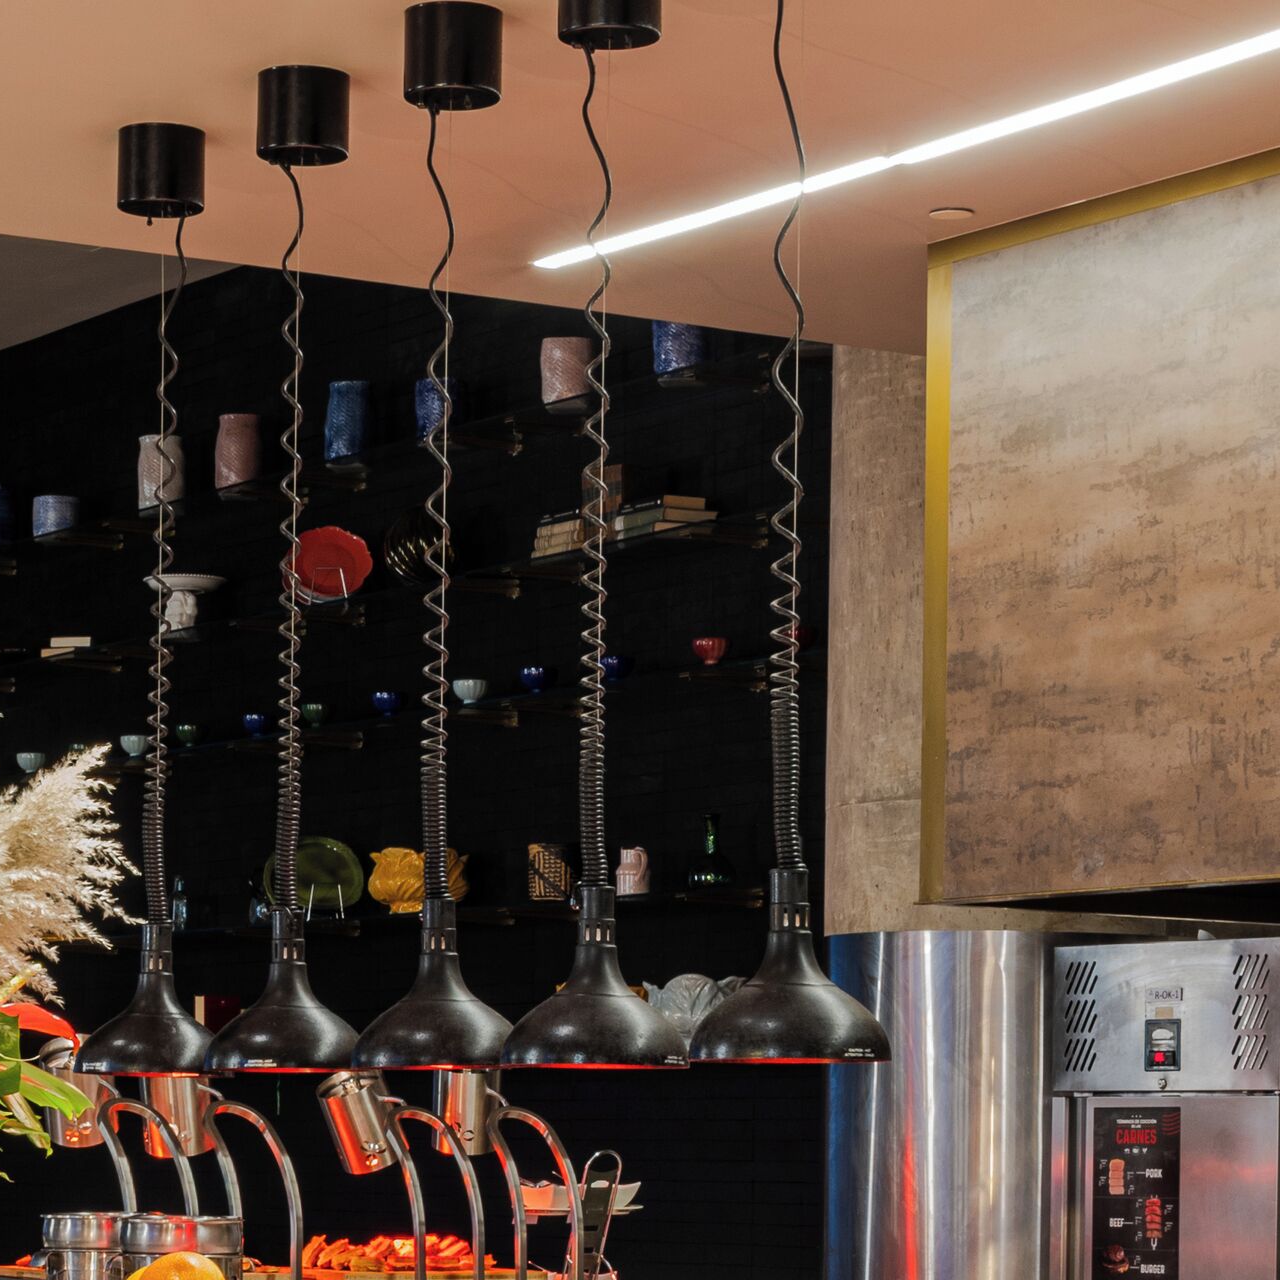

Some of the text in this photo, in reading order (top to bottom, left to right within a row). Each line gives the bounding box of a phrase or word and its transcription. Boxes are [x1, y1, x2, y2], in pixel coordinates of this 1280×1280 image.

[1116, 1129, 1158, 1145] CARNES
[1145, 1169, 1163, 1178] PORK
[1109, 1217, 1124, 1228] BEEF
[1140, 1264, 1165, 1274] BURGER
